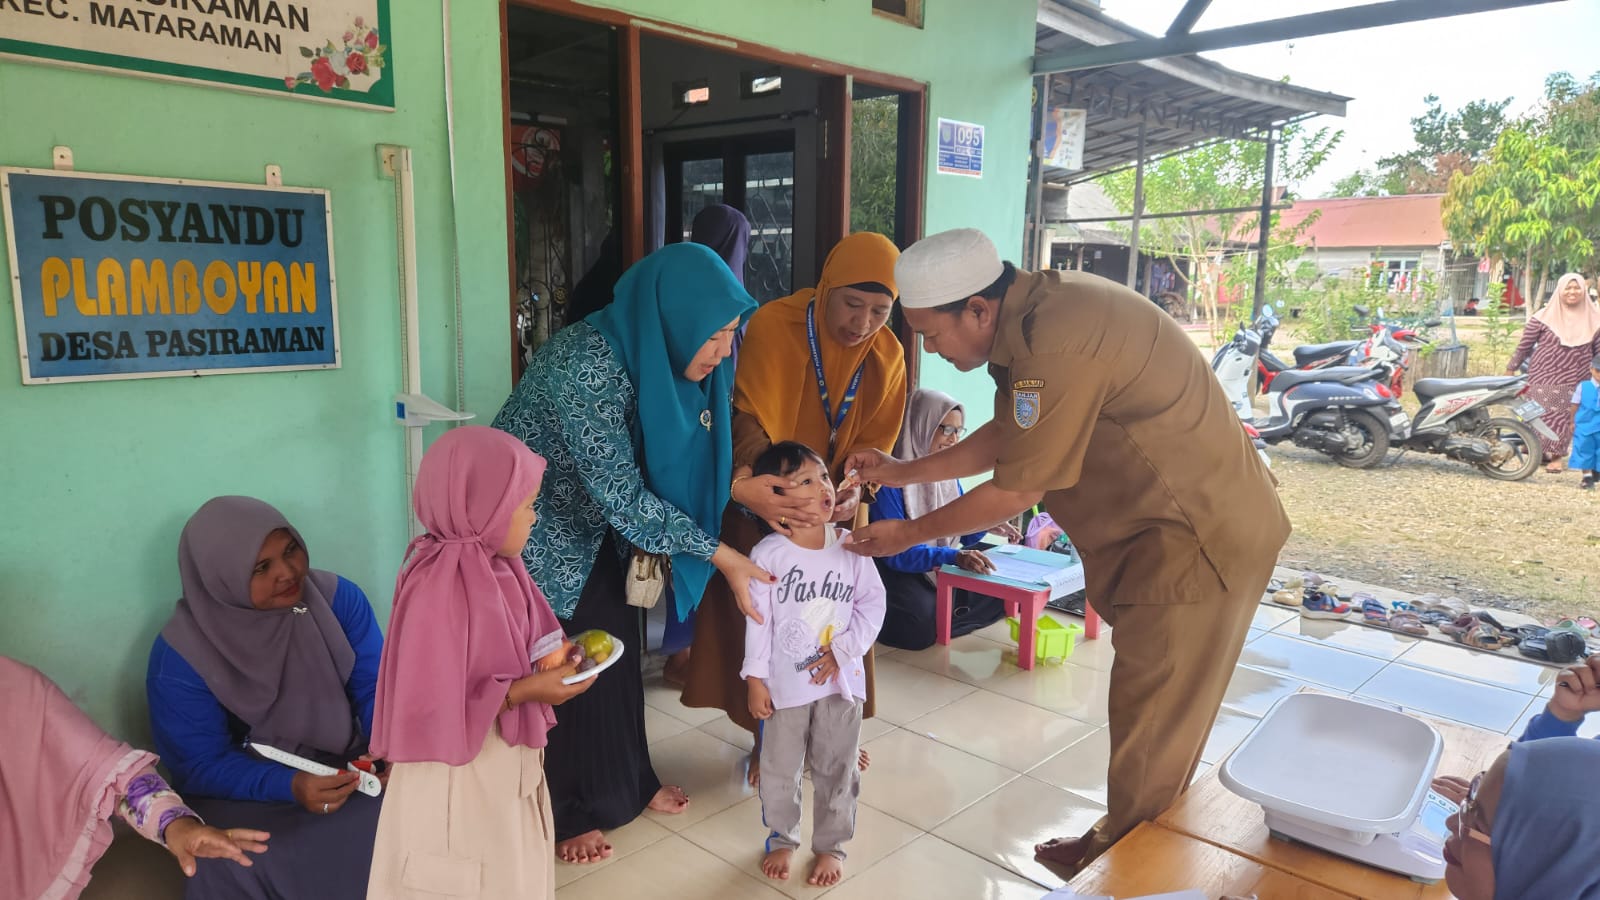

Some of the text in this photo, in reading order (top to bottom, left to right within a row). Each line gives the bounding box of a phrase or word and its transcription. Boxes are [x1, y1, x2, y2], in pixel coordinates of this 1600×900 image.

[90, 2, 282, 55] MATARAMAN
[957, 127, 980, 146] 095
[39, 195, 304, 247] POSYANDU
[41, 257, 317, 317] PLAMBOYAN
[39, 326, 325, 362] DESA PASIRAMAN
